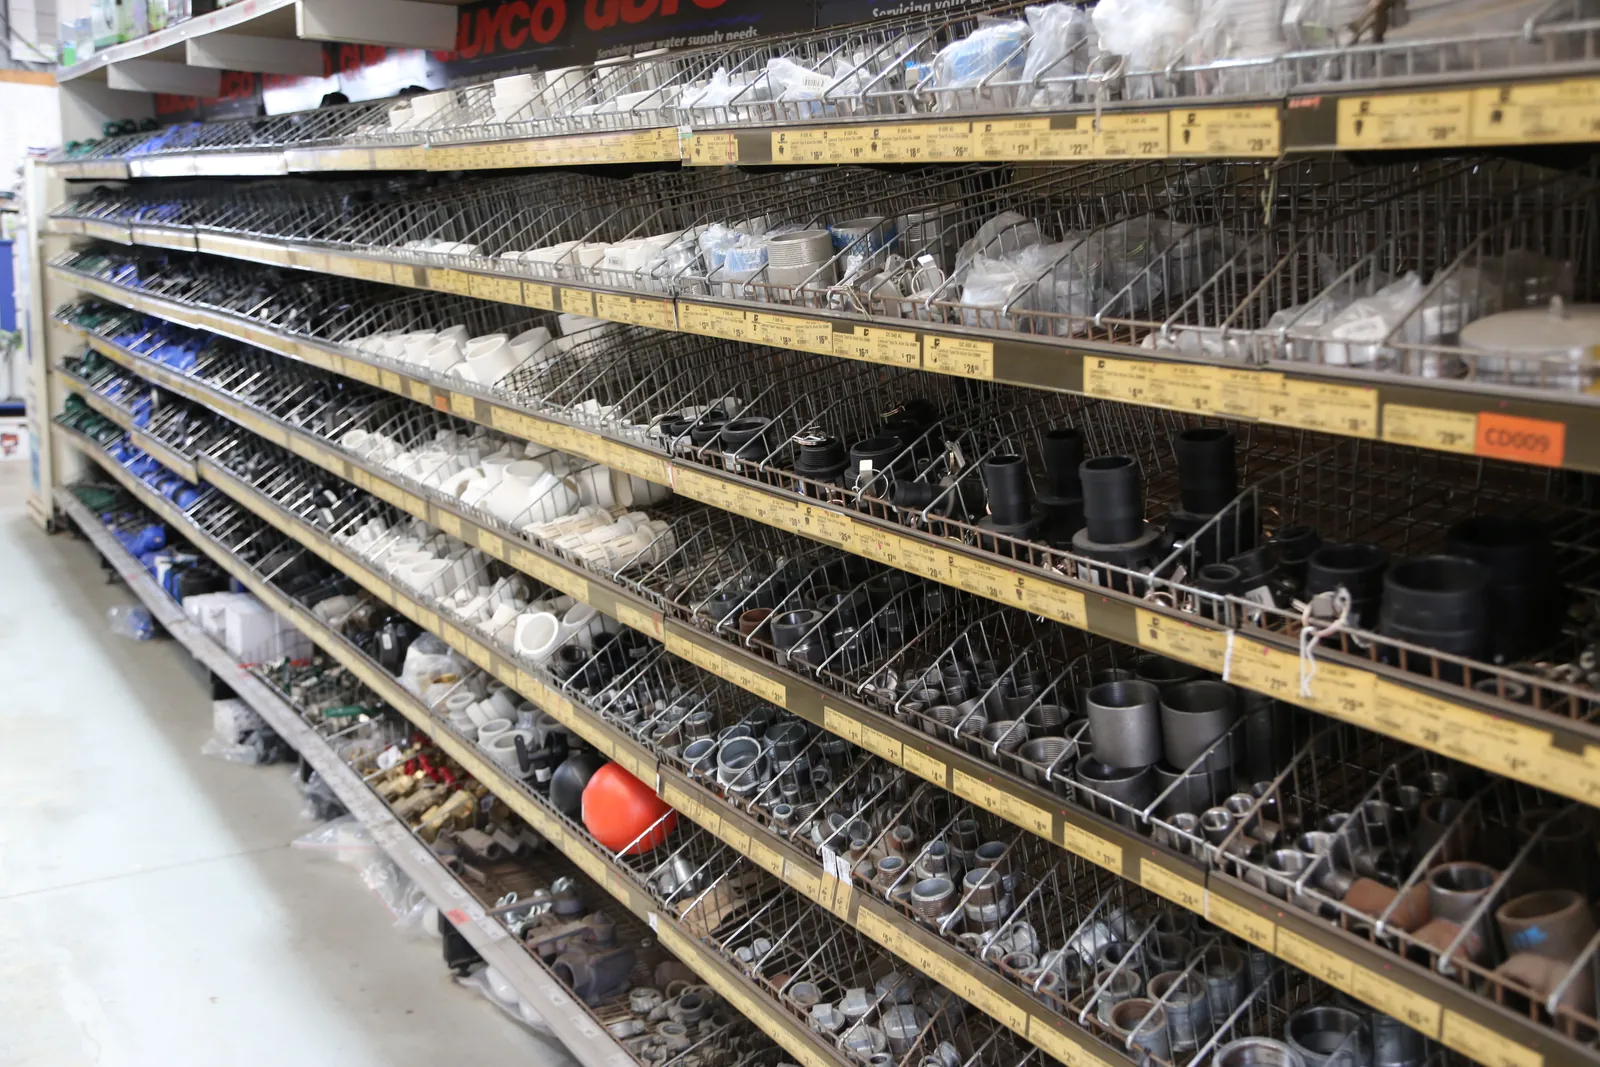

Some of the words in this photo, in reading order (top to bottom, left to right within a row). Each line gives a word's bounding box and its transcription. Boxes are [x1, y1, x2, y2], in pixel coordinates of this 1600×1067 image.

[433, 0, 567, 62] UYCO
[656, 36, 684, 50] water
[688, 30, 724, 46] supply
[726, 26, 758, 42] needs
[1484, 426, 1551, 452] CD009
